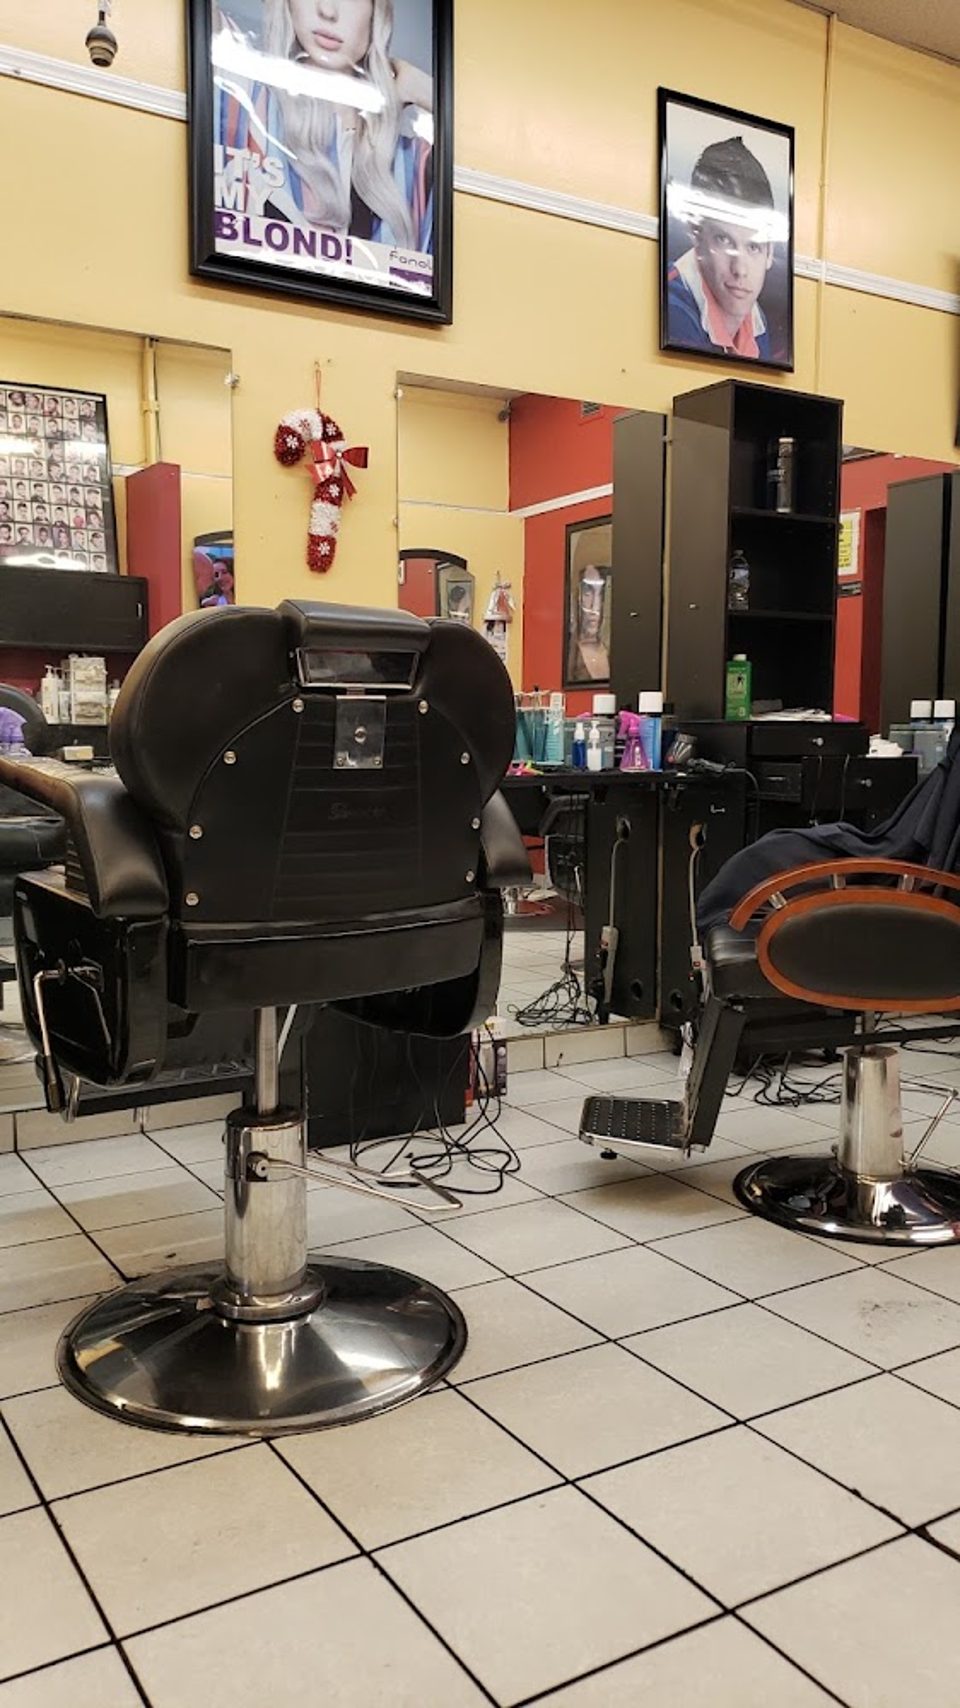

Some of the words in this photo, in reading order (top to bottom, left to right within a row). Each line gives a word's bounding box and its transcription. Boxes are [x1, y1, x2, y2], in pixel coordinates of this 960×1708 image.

[214, 145, 285, 188] IT'S
[215, 178, 274, 216] MY
[215, 210, 353, 265] BLOND!
